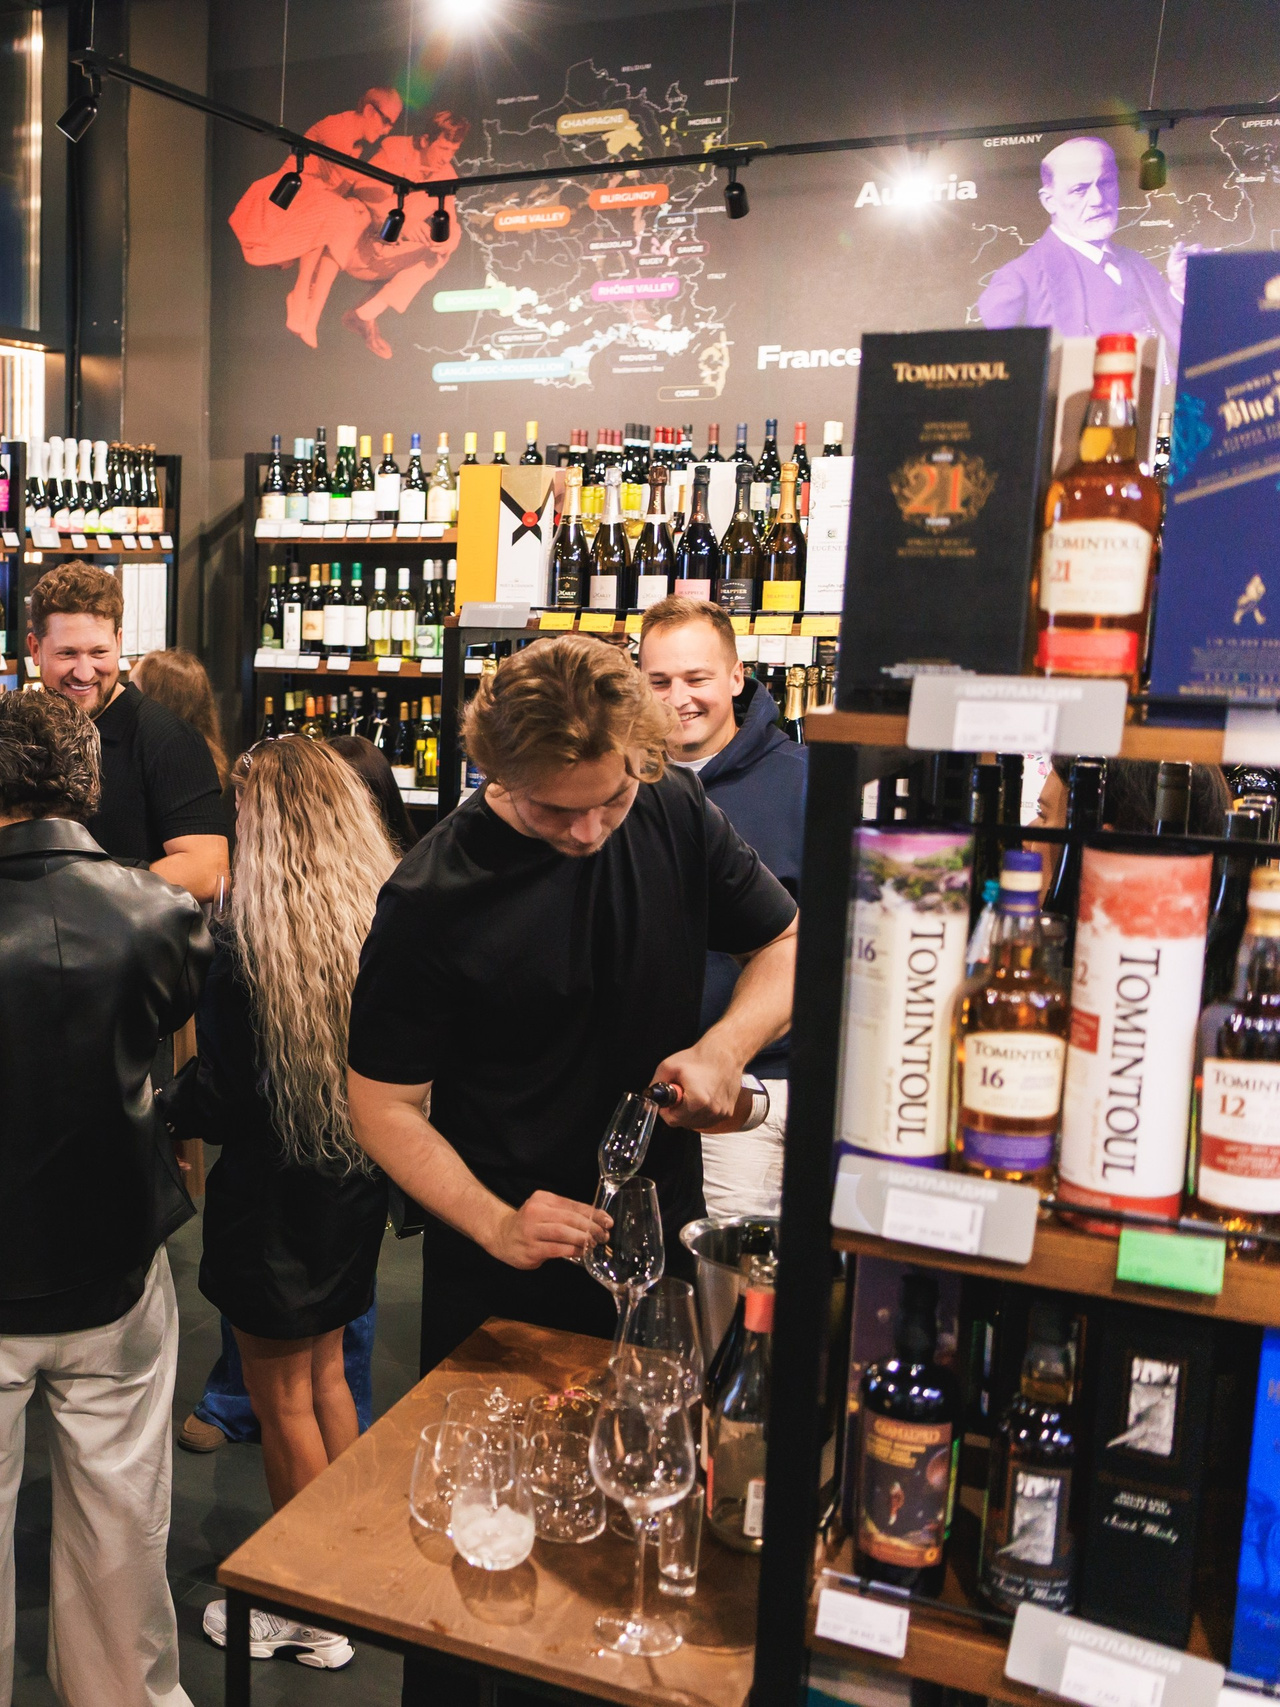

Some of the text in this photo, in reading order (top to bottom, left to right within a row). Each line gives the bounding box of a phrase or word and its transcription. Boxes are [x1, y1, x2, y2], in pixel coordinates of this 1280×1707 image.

[561, 114, 624, 129] CHAMPAGNE
[688, 116, 722, 126] MOSELLE
[1242, 120, 1271, 129] UPPER
[983, 134, 1043, 148] GERMANY
[600, 190, 658, 203] BURGUNDY
[499, 212, 566, 226] LOIRE VALLEY
[598, 282, 675, 296] RHÔNE VALLEY
[757, 345, 861, 370] France
[892, 361, 1010, 382] TOMINTOUL
[858, 937, 877, 962] 16
[896, 921, 947, 1144] TOMINTOUL
[1102, 947, 1161, 1180] TOMINTOUL
[980, 1066, 1005, 1089] 16
[1214, 1068, 1280, 1092] TOMINT
[1220, 1094, 1246, 1118] 12
